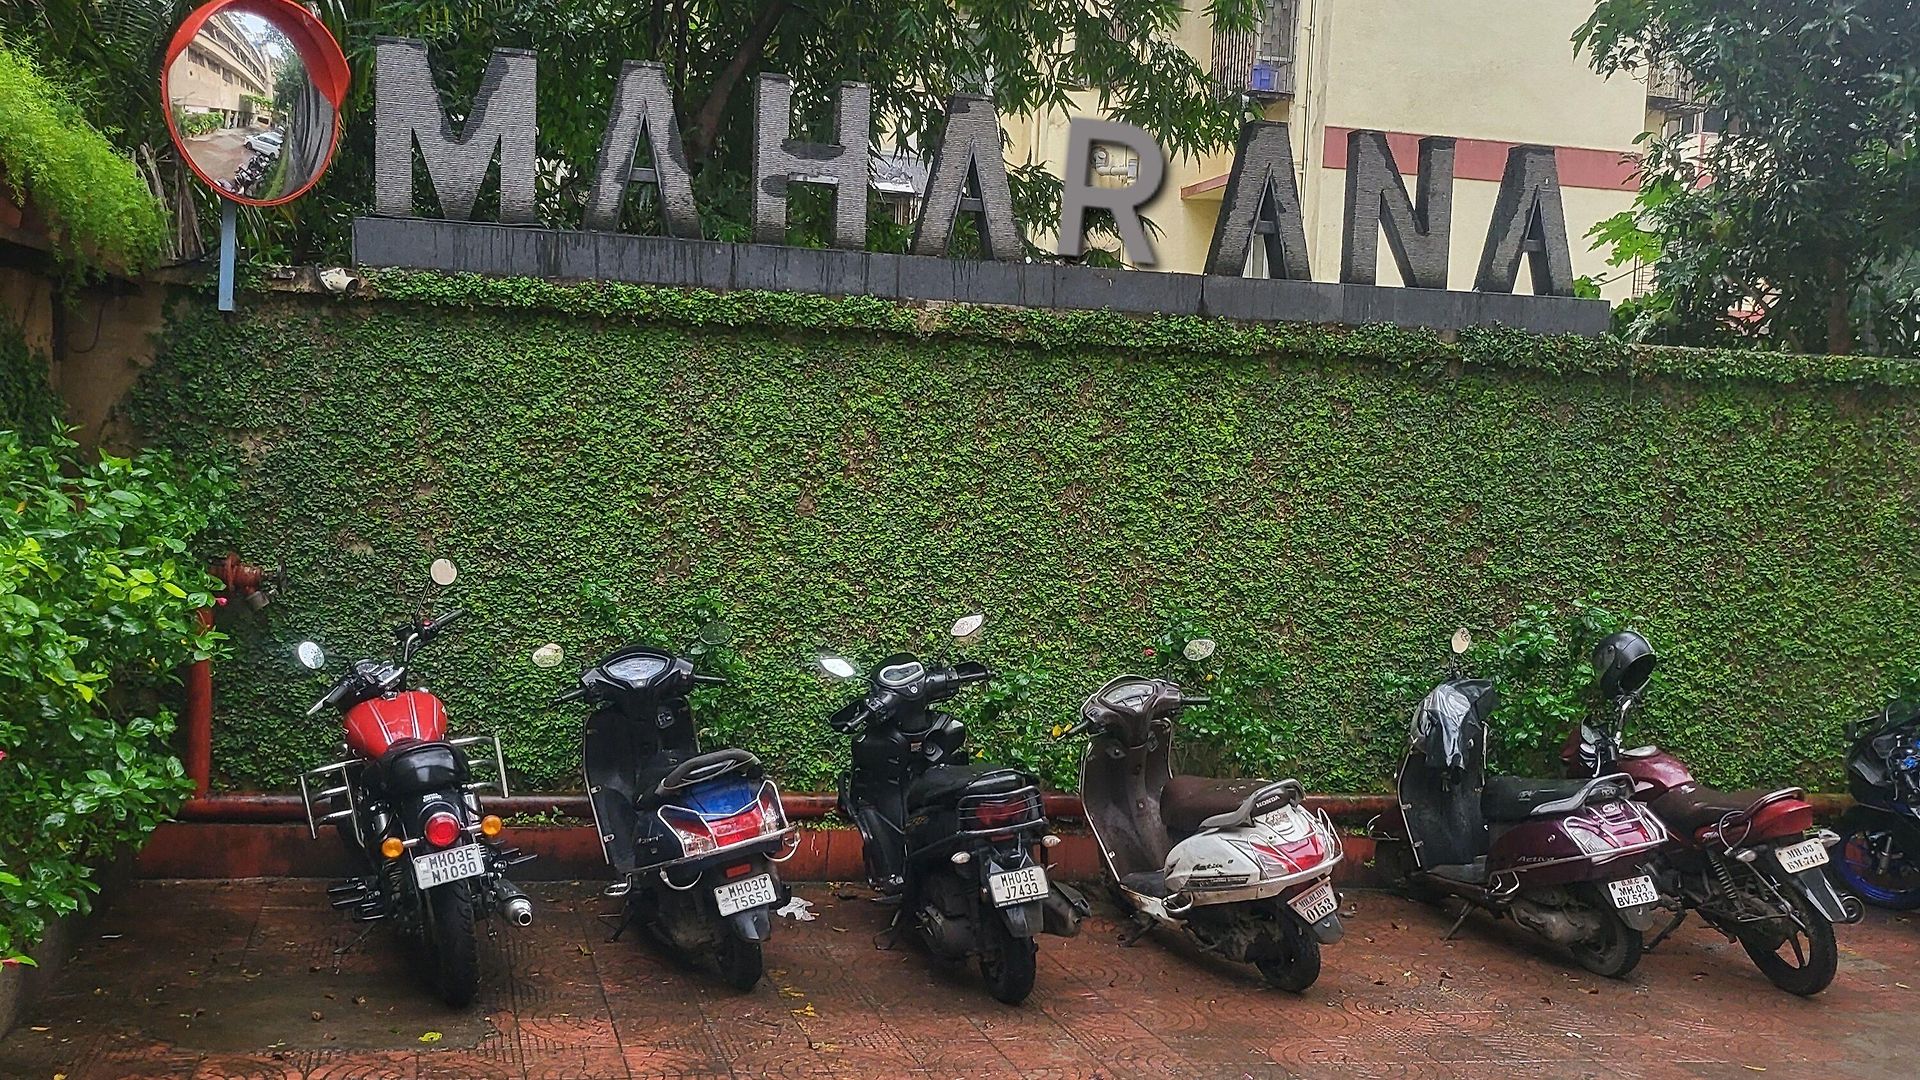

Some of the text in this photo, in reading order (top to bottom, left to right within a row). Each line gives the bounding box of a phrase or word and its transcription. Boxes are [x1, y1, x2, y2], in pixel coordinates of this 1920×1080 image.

[374, 36, 1577, 299] MAHARANA
[1255, 794, 1281, 808] HONDA
[428, 848, 475, 870] MH03E
[431, 861, 477, 883] N1030
[1000, 869, 1036, 887] MH03E
[727, 878, 767, 898] MH03D
[1005, 882, 1039, 899] J7433
[731, 889, 772, 910] T5650
[1306, 897, 1334, 921] 0153
